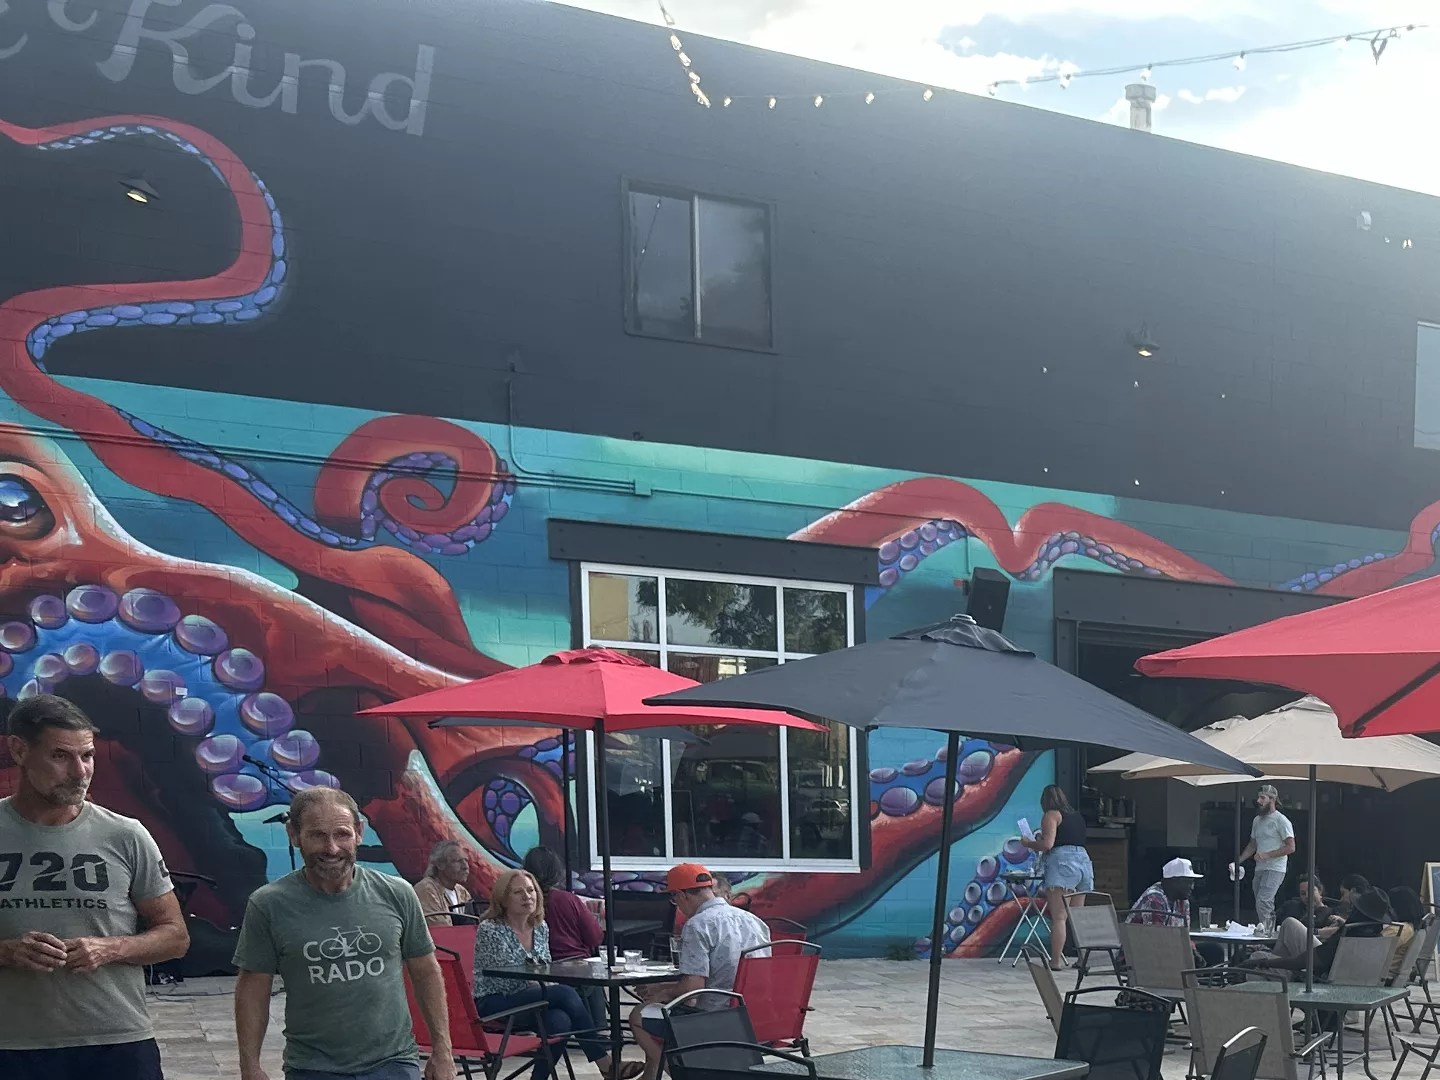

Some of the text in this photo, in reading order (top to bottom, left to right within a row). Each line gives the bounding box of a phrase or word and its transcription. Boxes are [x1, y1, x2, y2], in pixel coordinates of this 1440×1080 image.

[97, 0, 436, 136] Kind
[0, 851, 110, 892] 720
[0, 898, 108, 909] ATHLETICS
[308, 957, 386, 984] RADO
